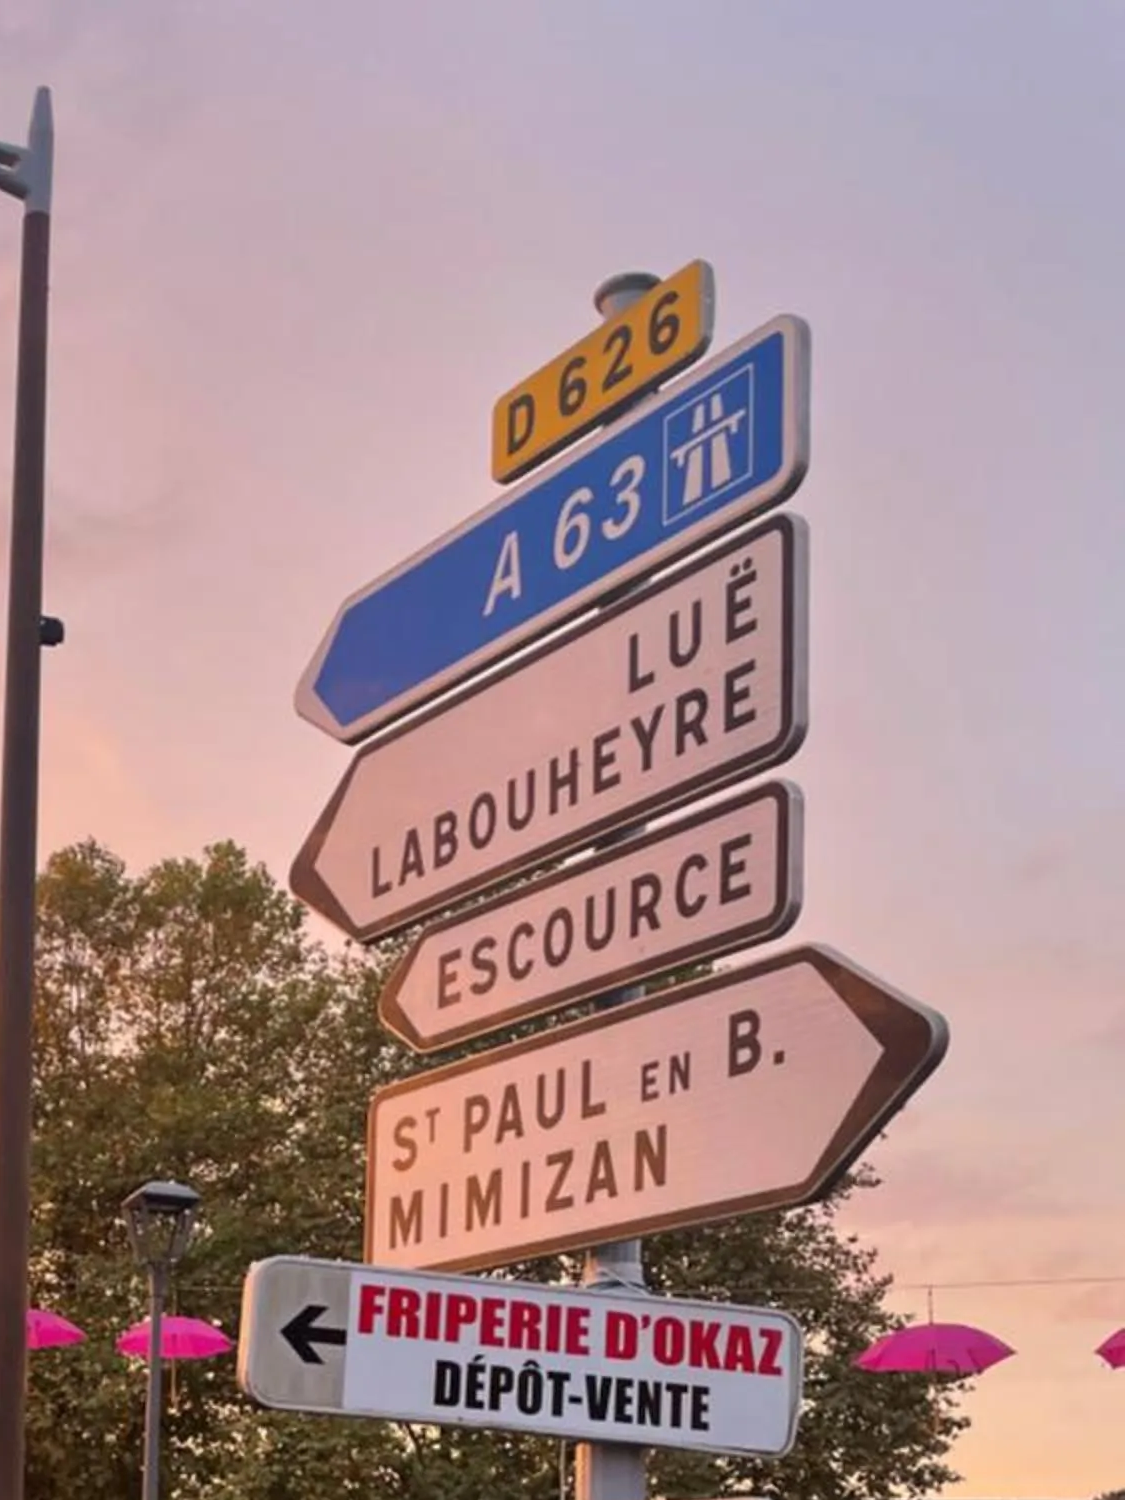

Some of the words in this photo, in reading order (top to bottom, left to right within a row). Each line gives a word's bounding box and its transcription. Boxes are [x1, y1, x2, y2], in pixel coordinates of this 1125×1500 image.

[507, 395, 535, 456] D
[559, 291, 680, 418] 626
[483, 531, 522, 617] A
[553, 454, 645, 570] 63
[628, 557, 757, 694] LUË
[372, 659, 757, 899] LABOUHEYRE
[438, 834, 752, 1008] ESCOURCE
[463, 1059, 606, 1152] PAUL
[641, 1051, 691, 1101] EN
[728, 1010, 786, 1078] B.
[388, 1124, 668, 1249] MIMIZAN
[357, 1285, 590, 1356] FRIPERIE
[606, 1311, 783, 1376] D'OKAZ
[434, 1354, 710, 1431] DÉPÔT-VENTE
